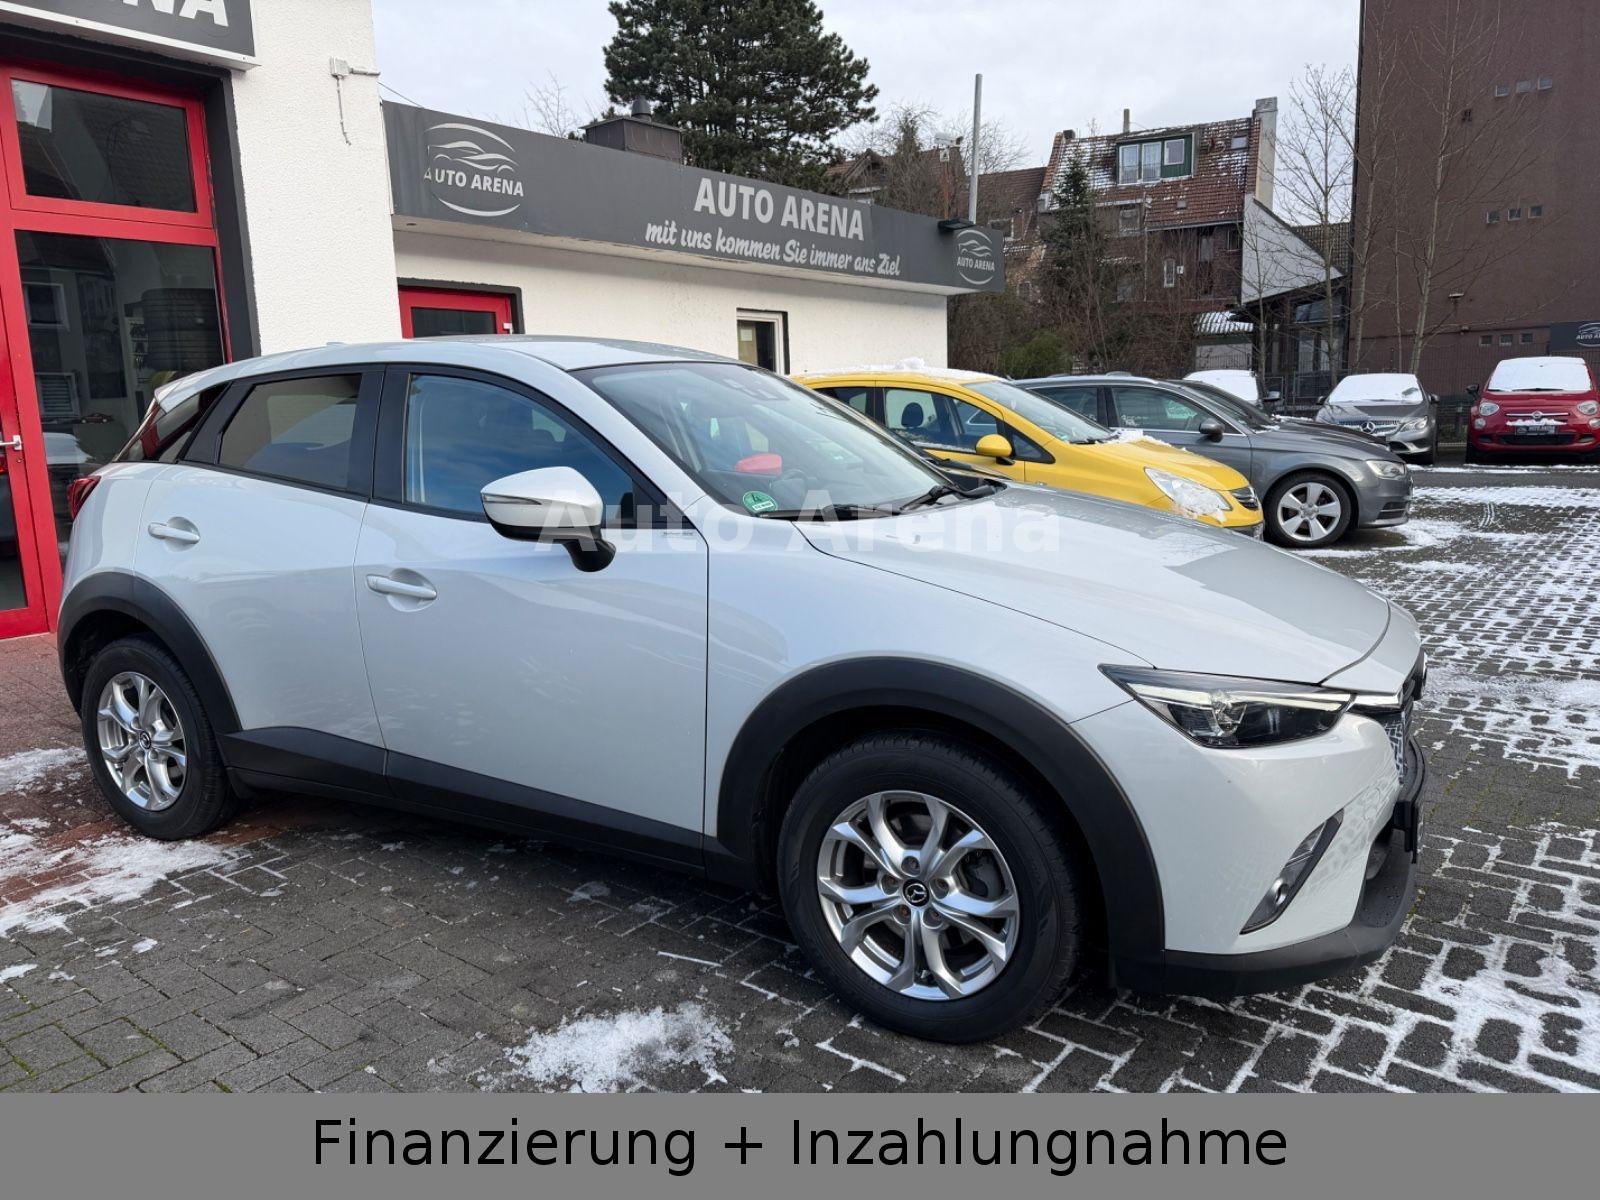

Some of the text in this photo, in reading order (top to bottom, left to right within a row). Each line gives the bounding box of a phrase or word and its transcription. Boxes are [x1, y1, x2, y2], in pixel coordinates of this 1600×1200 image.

[423, 167, 524, 197] AUTO ARENA
[694, 177, 864, 241] AUTO ARENA
[645, 220, 900, 276] mit uns kommen Sie immer ans Ziel
[957, 256, 995, 271] AUTO ARENA
